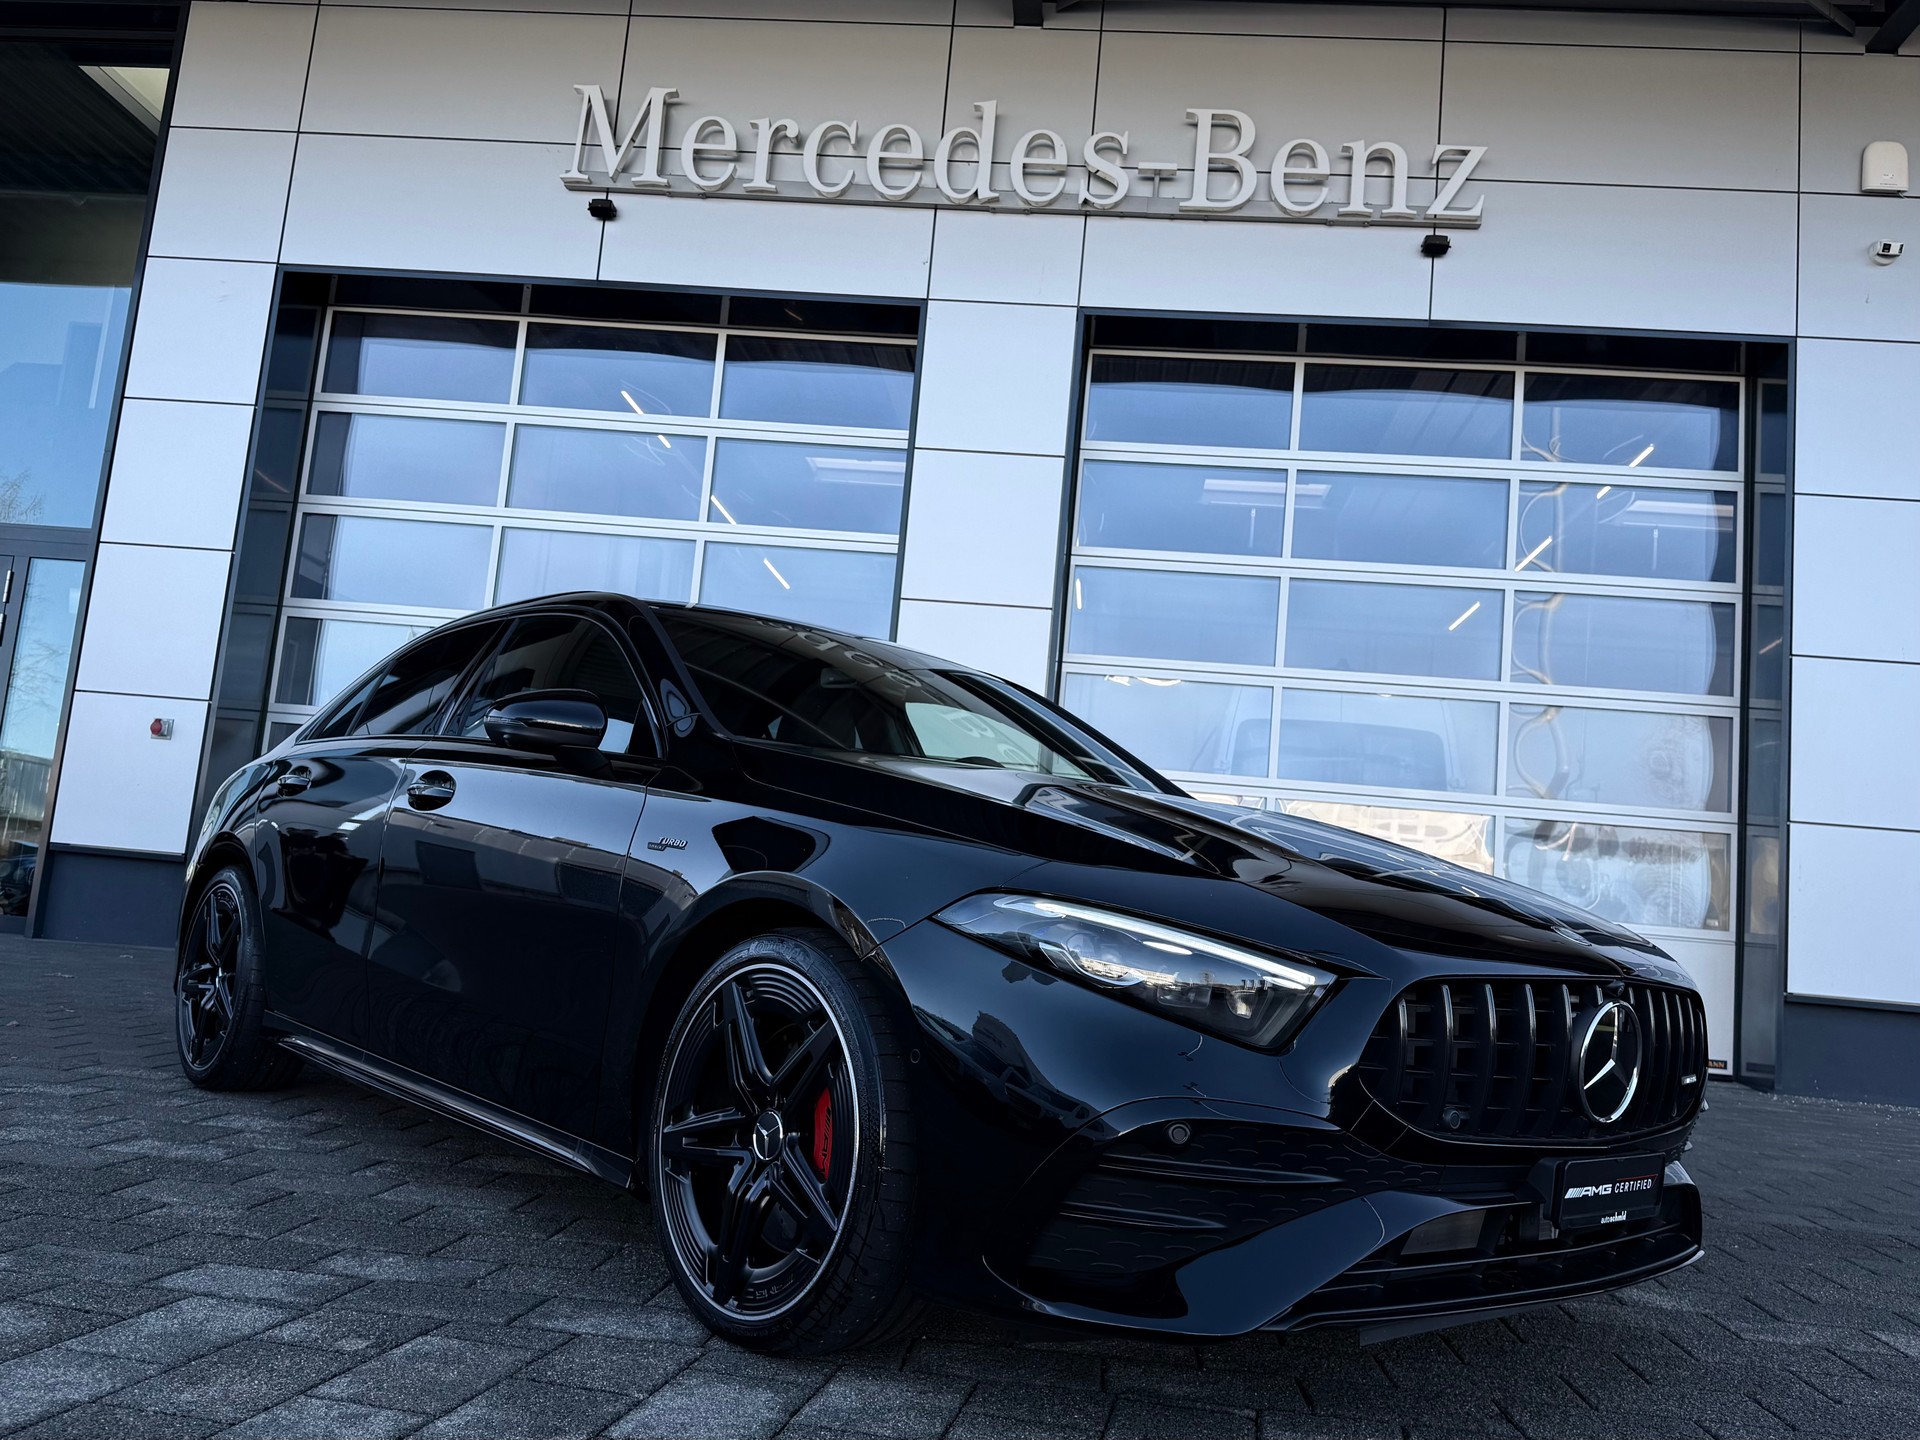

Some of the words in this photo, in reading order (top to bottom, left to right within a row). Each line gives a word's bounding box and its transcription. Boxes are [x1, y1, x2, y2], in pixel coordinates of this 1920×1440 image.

[563, 83, 1490, 219] Mercedes-Benz
[1580, 1184, 1612, 1197] AMG
[1614, 1178, 1652, 1193] CERTIFIED
